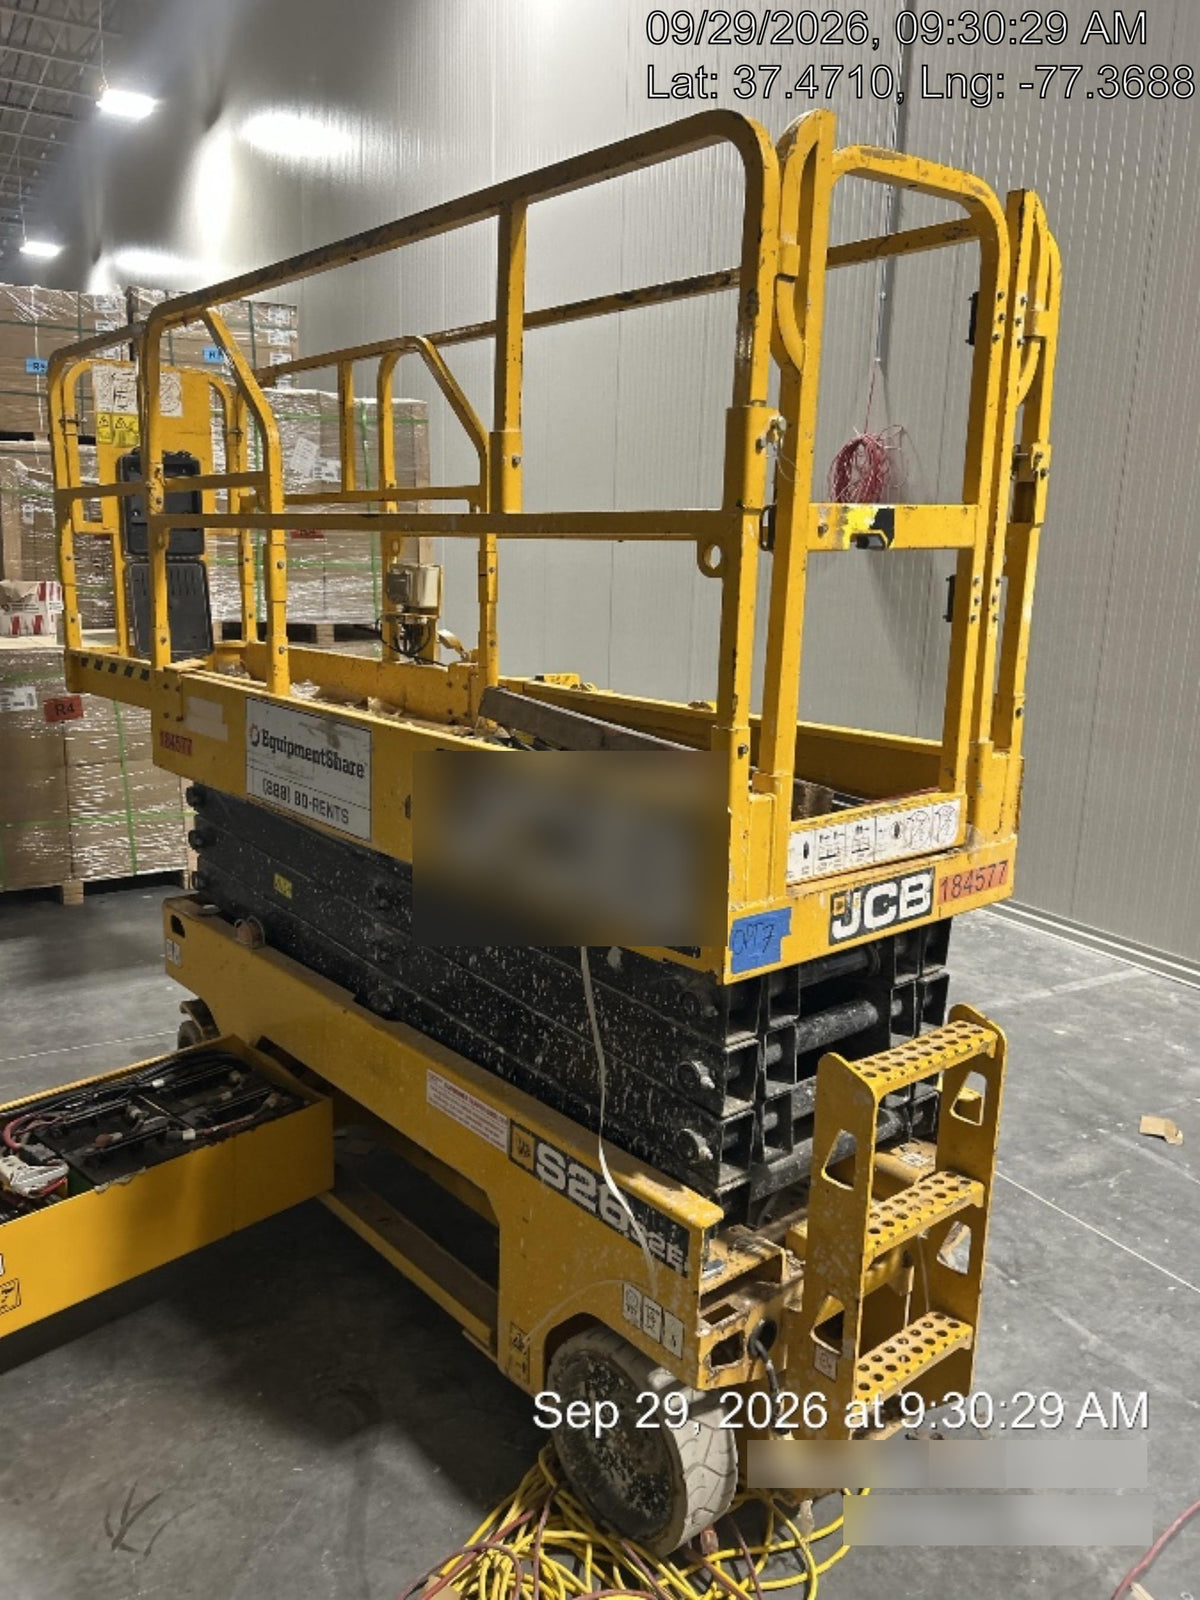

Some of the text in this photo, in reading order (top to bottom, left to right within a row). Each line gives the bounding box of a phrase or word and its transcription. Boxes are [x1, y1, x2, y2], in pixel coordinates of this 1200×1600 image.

[55, 703, 75, 716] R4
[262, 728, 365, 779] EquipmentShare
[940, 860, 1008, 903] 184577
[831, 872, 932, 940] JCB
